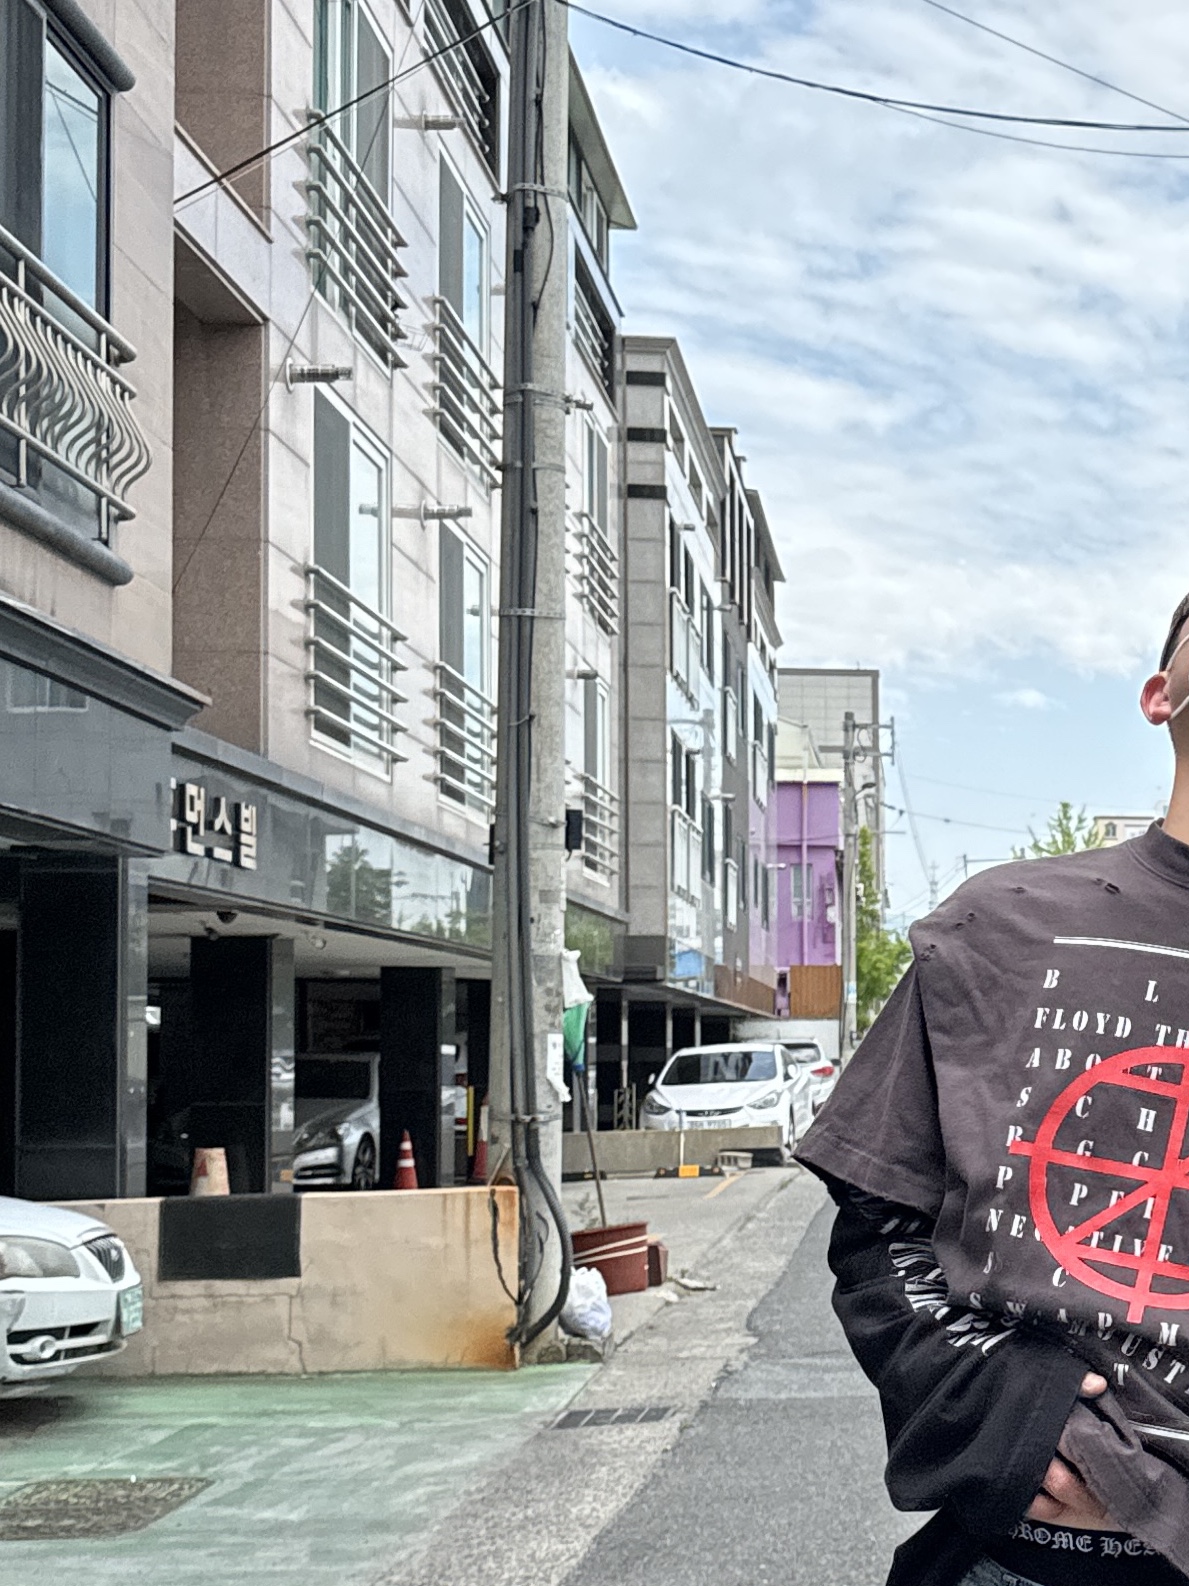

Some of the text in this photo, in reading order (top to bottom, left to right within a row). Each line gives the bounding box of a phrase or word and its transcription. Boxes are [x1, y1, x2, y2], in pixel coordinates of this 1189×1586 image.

[170, 777, 257, 870] 먼스빌
[1034, 1007, 1132, 1038] FLOYD
[1025, 1047, 1163, 1081] ABOT
[1008, 1521, 1094, 1553] ROME
